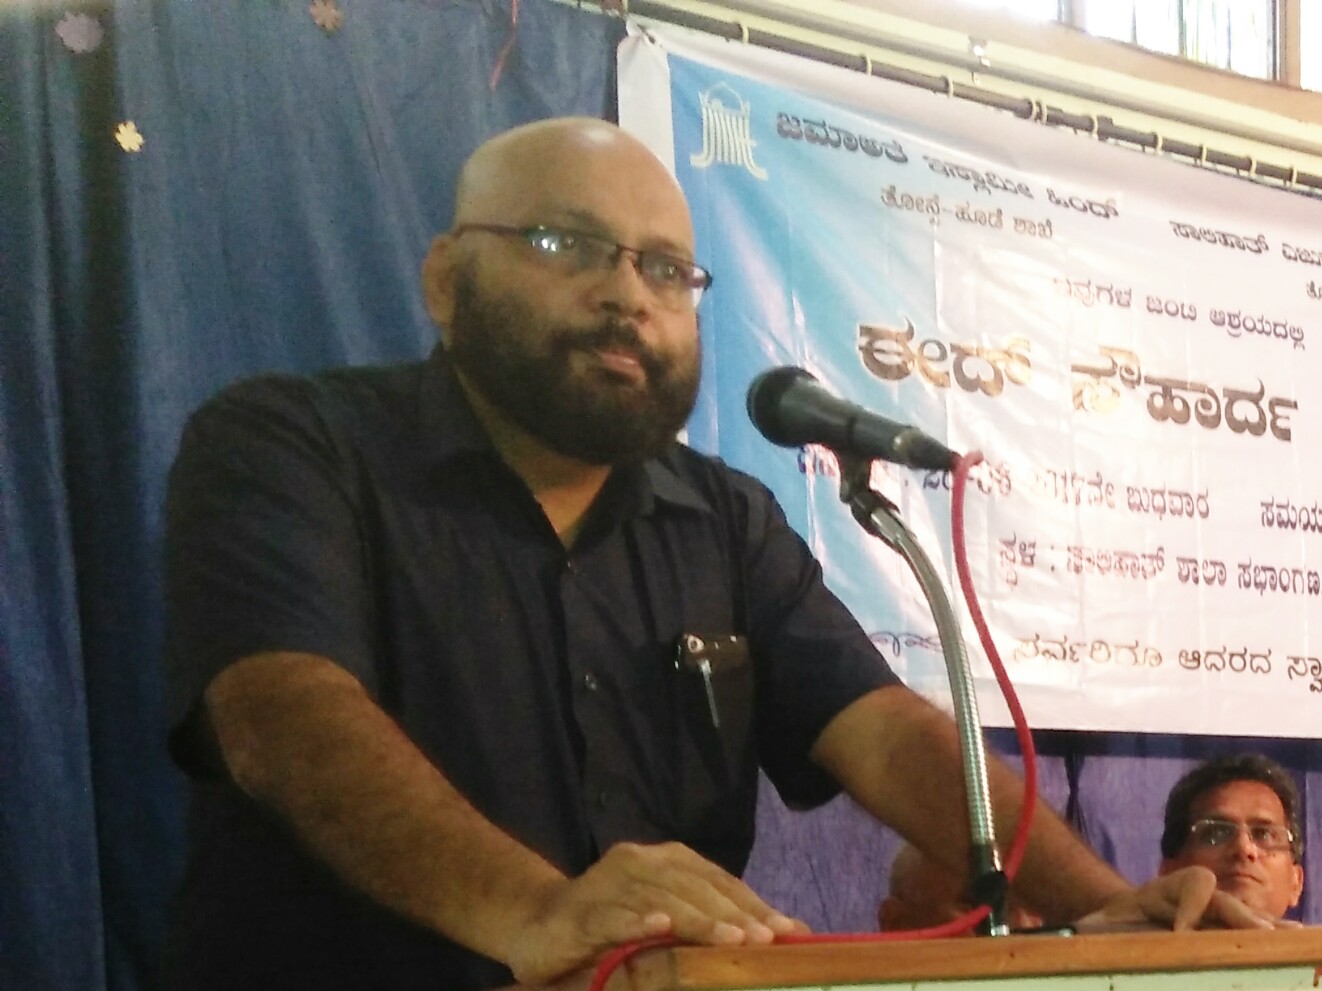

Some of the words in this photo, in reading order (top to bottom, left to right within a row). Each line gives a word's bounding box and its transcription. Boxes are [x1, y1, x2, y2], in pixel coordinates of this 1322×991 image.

[1046, 187, 1119, 218] ಹಿಂದ್
[1012, 217, 1053, 239] ಶಾಖೆ
[1146, 294, 1197, 321] ಜಂಟಿ
[1209, 308, 1305, 350] ಆಶ್ರಯದಲ್ಲಿ
[856, 316, 1032, 397] ಈದ್
[1070, 345, 1299, 442] ಸೌಹಾರ್ದ
[1127, 483, 1211, 520] ಬುಧವಾರ
[1176, 554, 1227, 586] ಶಾಲಾ
[1178, 647, 1272, 675] ಆದರದ
